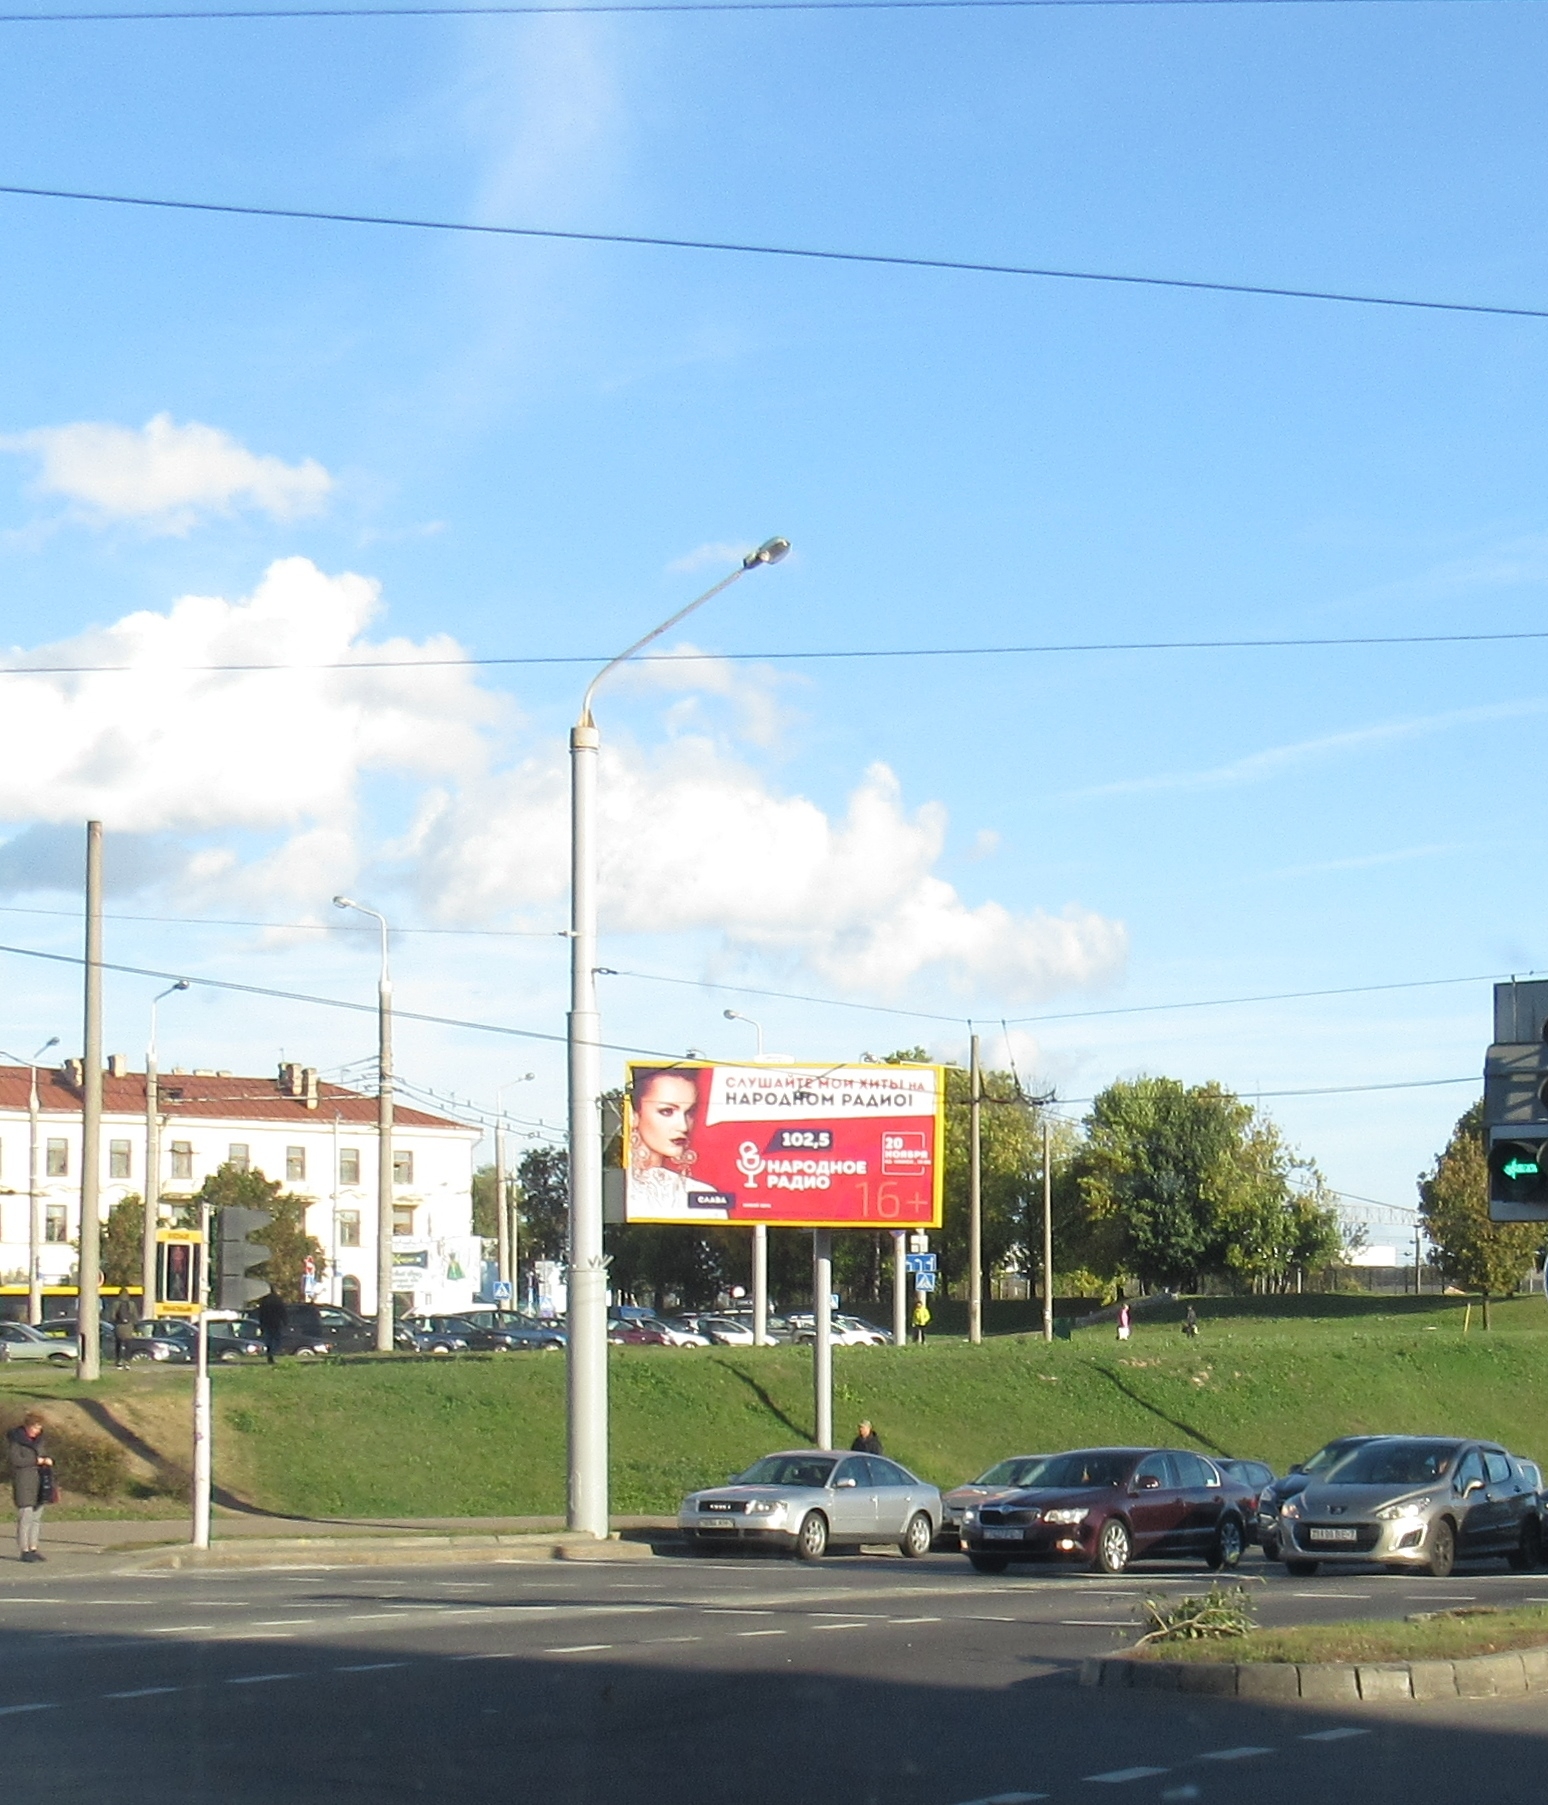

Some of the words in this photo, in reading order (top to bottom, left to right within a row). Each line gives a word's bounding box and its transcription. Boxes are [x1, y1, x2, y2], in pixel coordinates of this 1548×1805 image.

[726, 1073, 812, 1089] СЛУШАЙТЕ
[909, 1082, 925, 1091] НА
[725, 1092, 835, 1107] НАРОДНОМ
[782, 1131, 831, 1149] 102,5
[885, 1136, 904, 1150] 20
[884, 1150, 929, 1159] НОЯБРЯ
[767, 1160, 868, 1175] НАРОДНОЕ
[767, 1175, 831, 1190] РАДИО
[697, 1195, 728, 1204] СЛАВА
[855, 1181, 928, 1218] 16+
